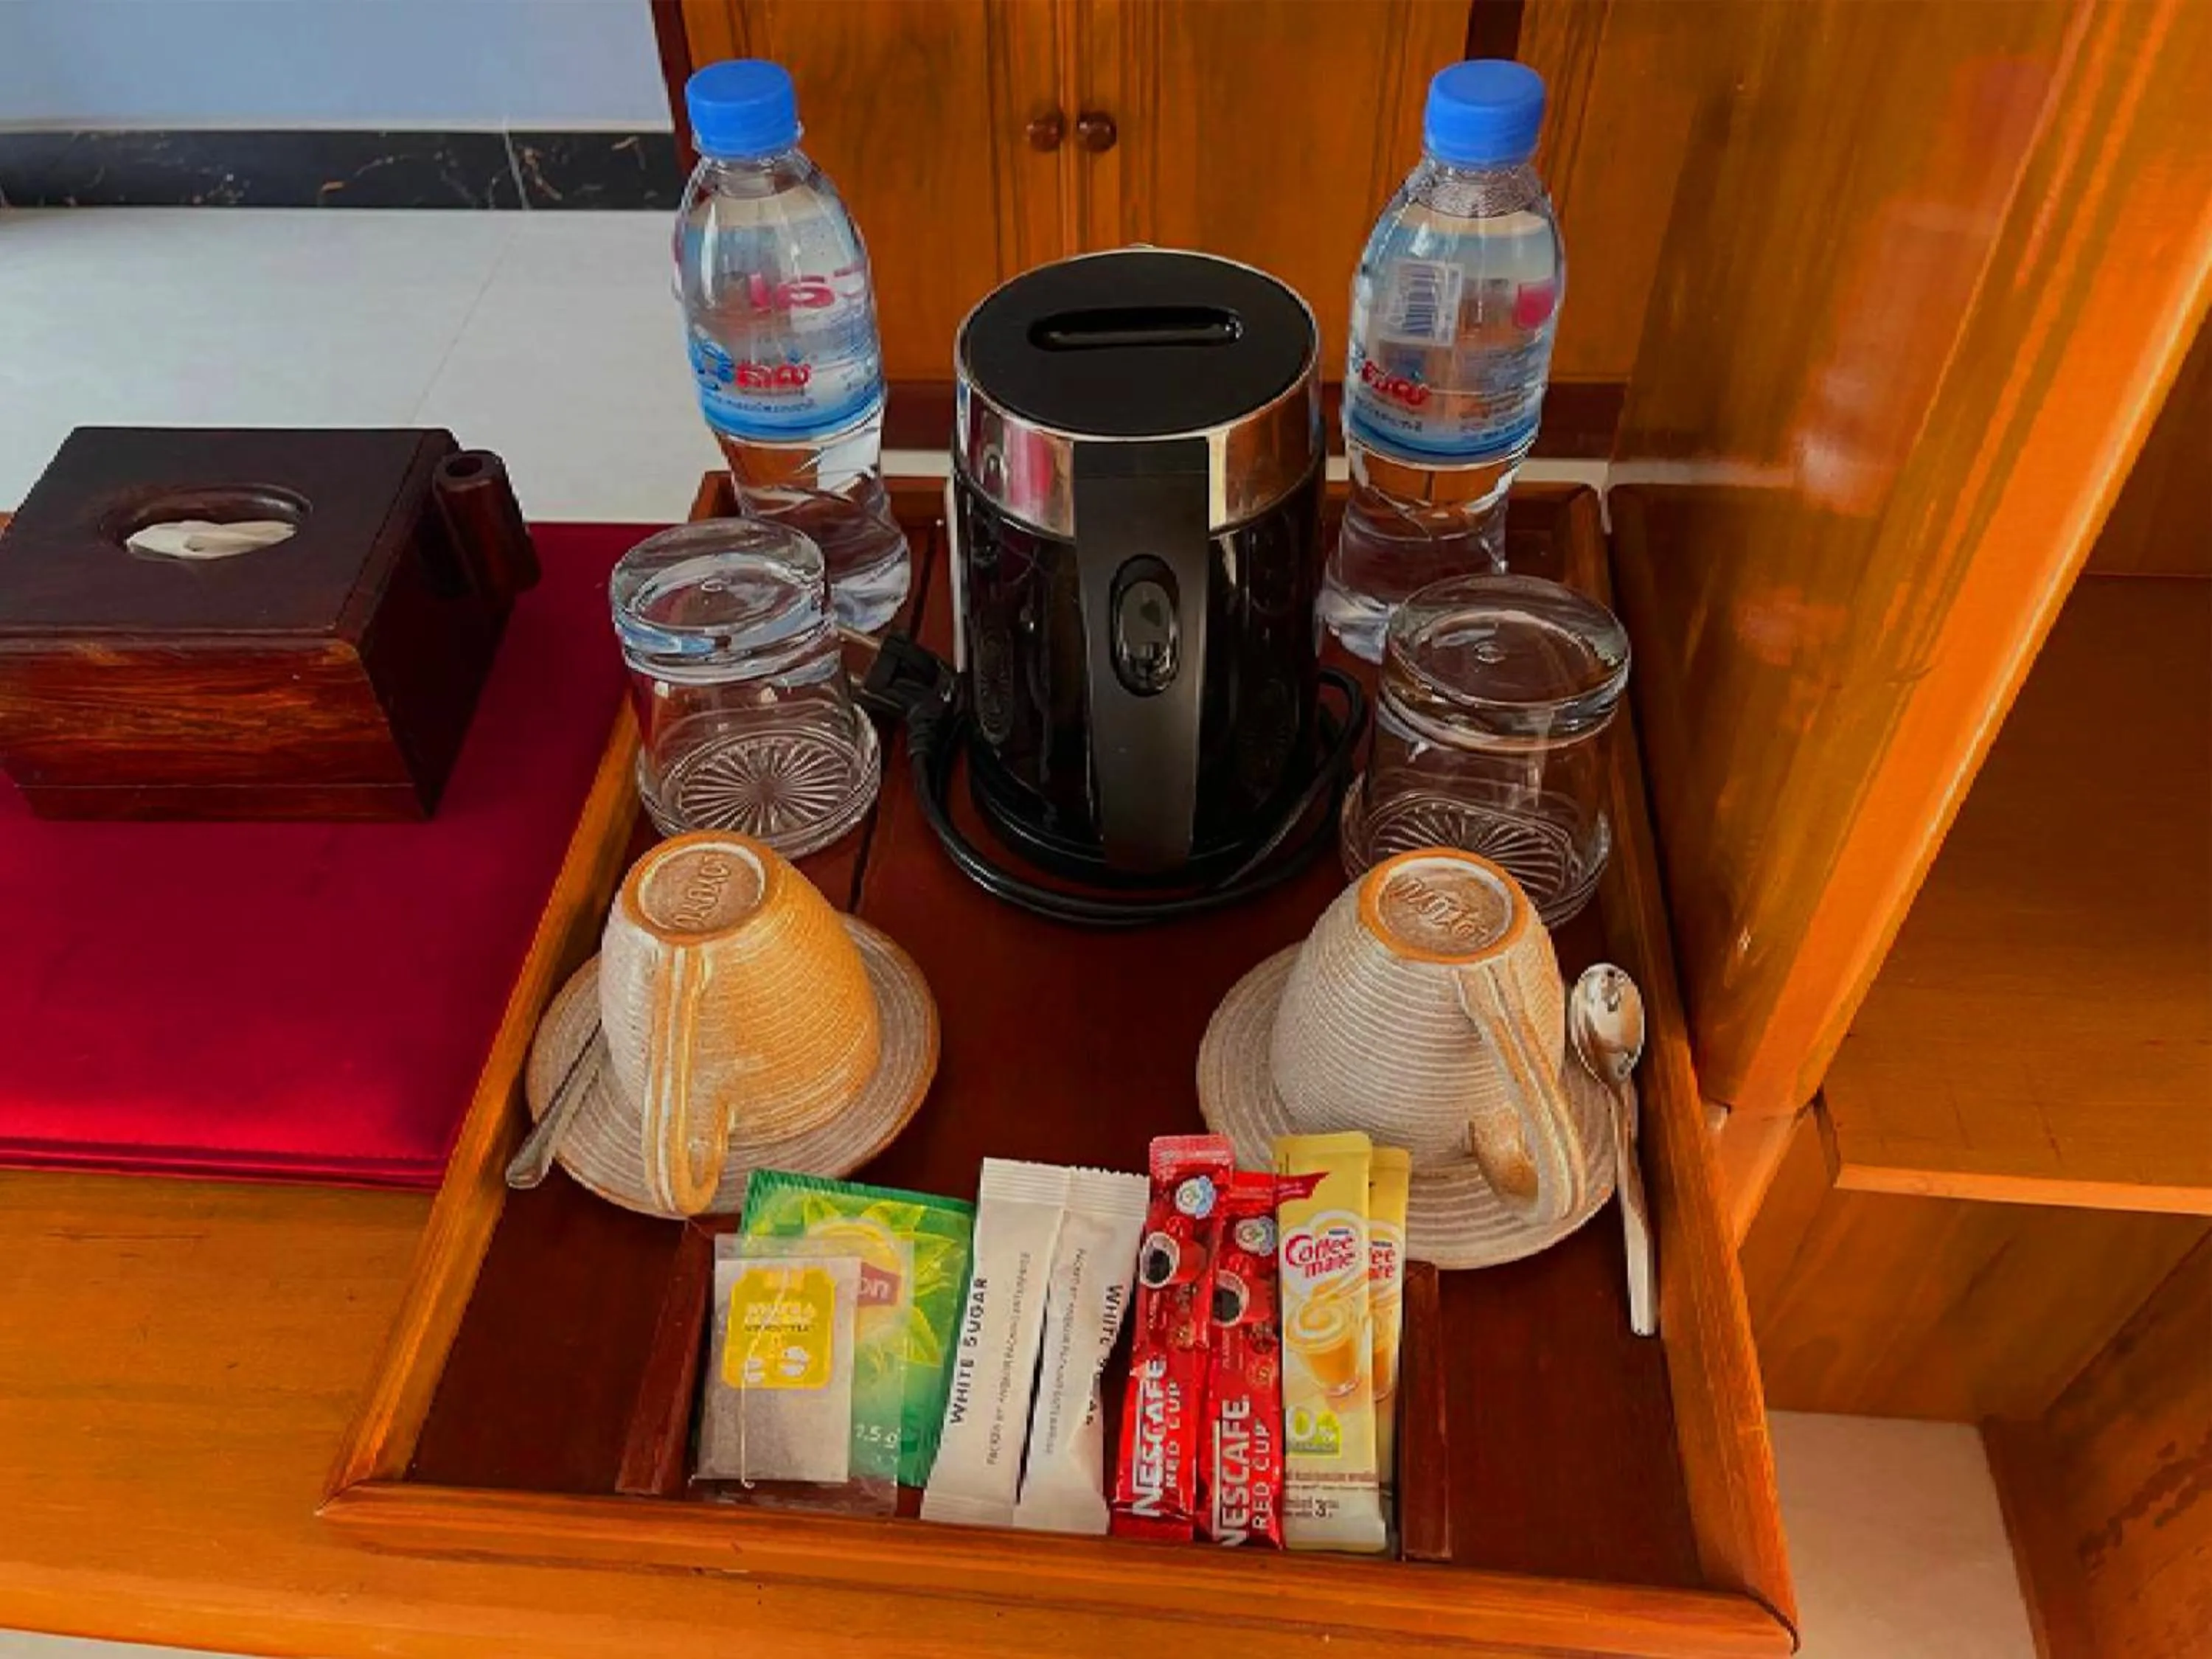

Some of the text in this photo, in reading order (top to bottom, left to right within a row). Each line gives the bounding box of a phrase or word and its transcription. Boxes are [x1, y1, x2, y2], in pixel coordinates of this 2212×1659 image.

[950, 1278, 988, 1424] WHITE SUGAR
[1166, 1381, 1178, 1489] RED CUP
[1253, 1418, 1273, 1531] RED CUP
